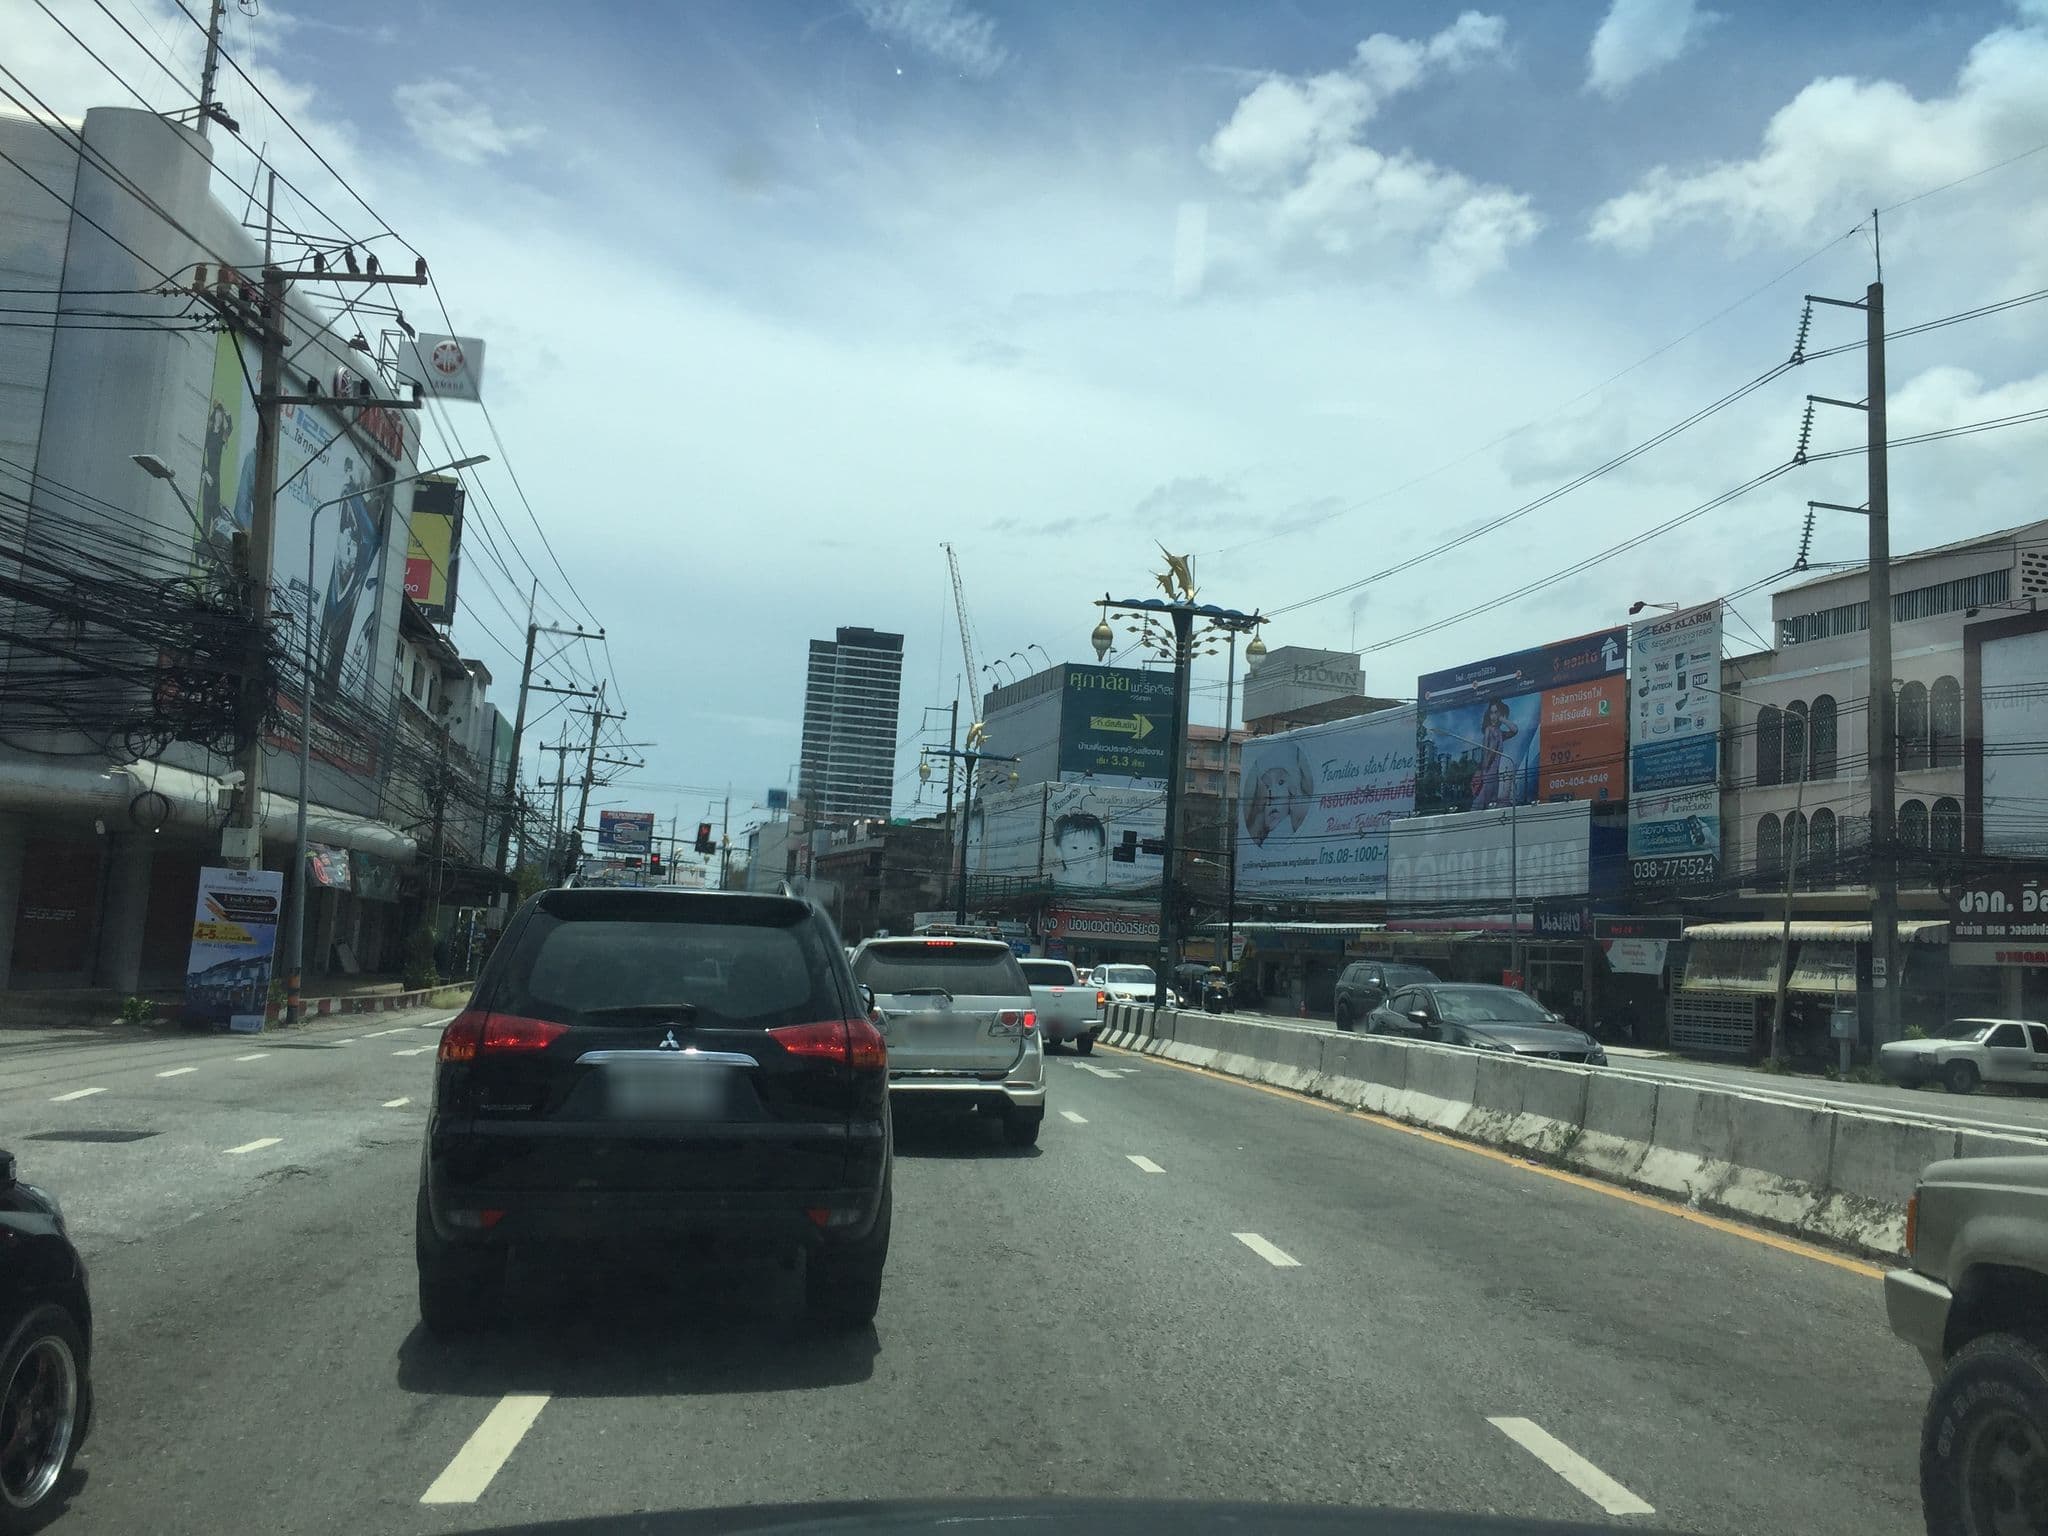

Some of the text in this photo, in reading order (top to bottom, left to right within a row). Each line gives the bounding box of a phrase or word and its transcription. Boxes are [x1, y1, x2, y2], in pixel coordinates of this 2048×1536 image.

[1652, 611, 1712, 636] EAS ALARM
[1111, 755, 1129, 767] 3.3
[1321, 758, 1360, 784] Families
[1363, 752, 1389, 776] start
[1633, 857, 1713, 879] 038-775524
